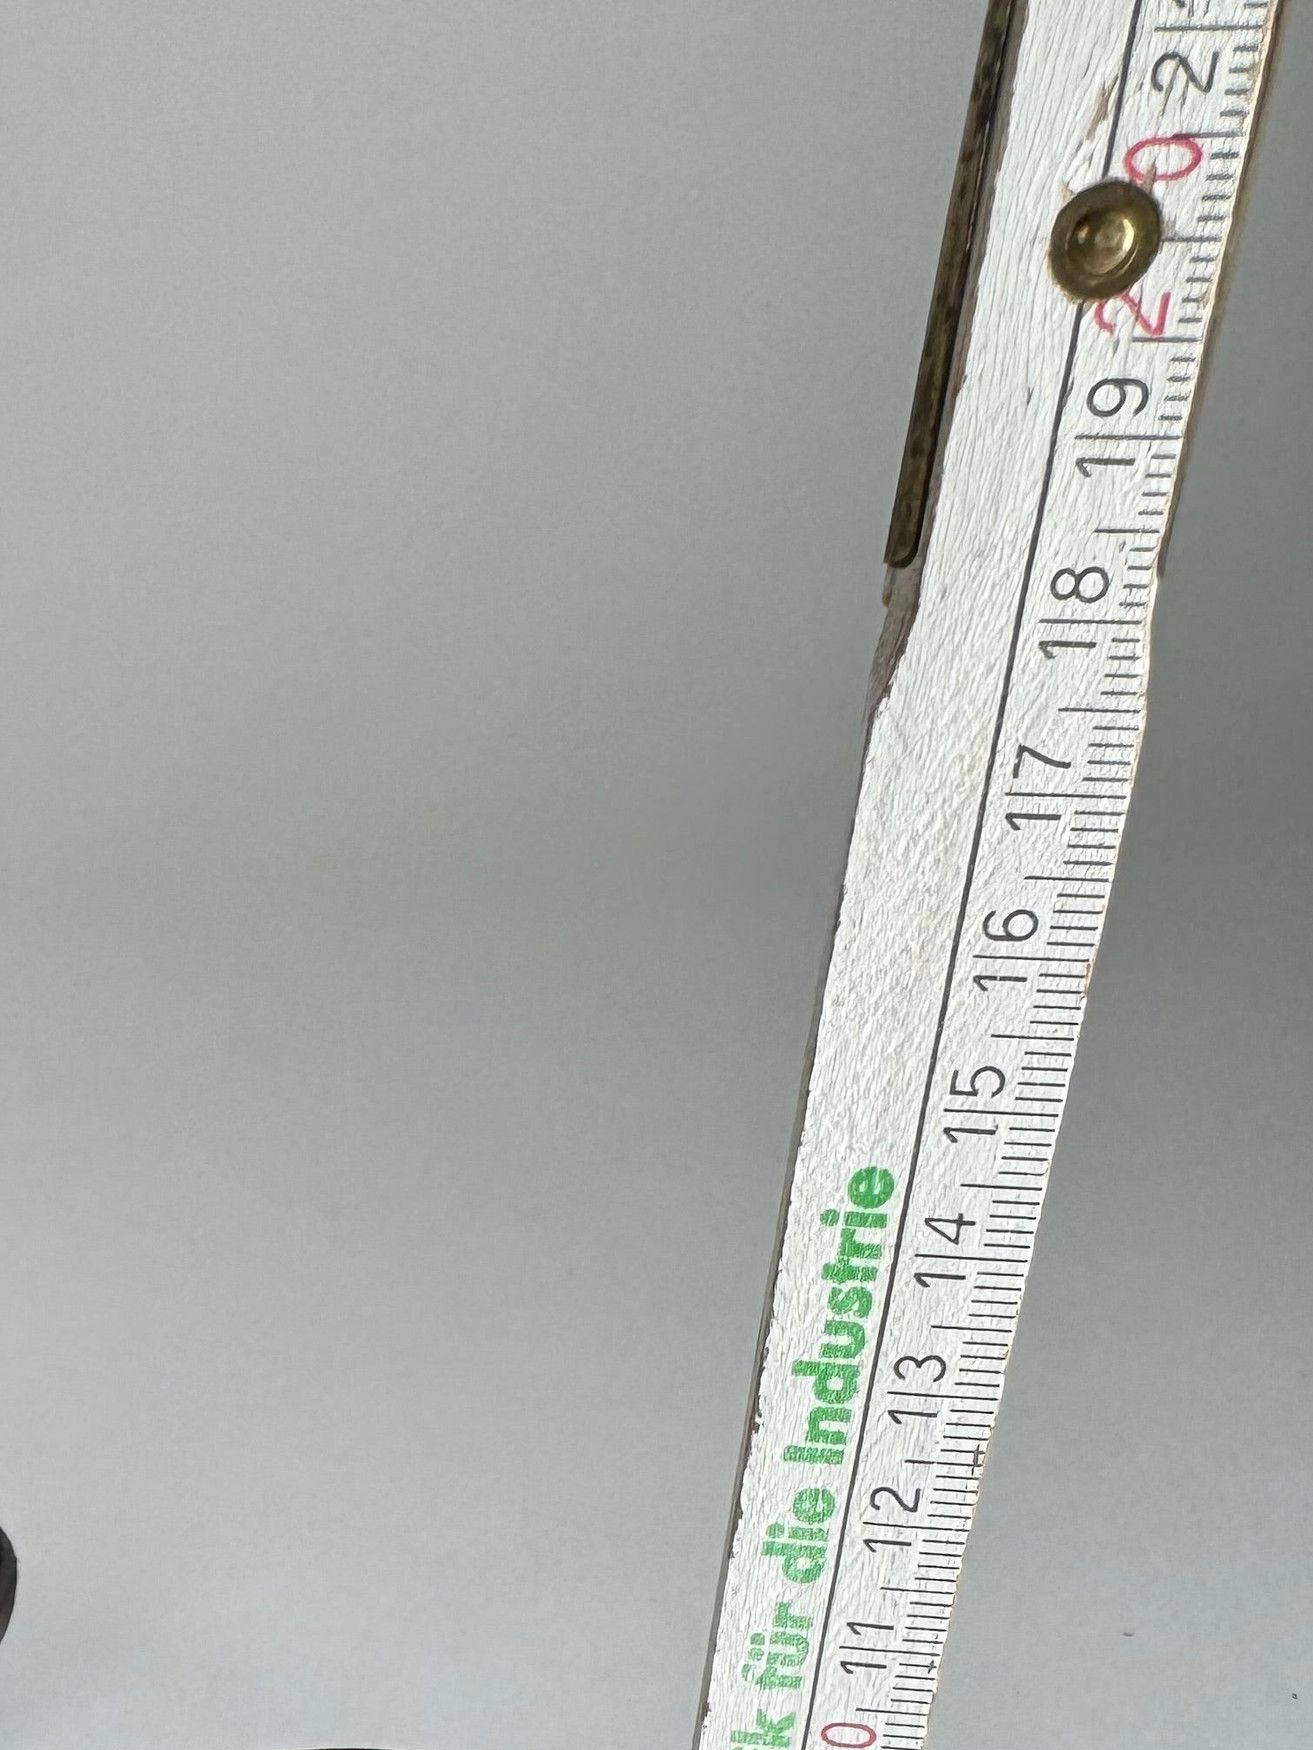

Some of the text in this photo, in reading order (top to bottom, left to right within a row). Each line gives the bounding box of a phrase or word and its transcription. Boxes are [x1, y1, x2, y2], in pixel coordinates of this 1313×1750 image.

[1150, 0, 1220, 94] 2
[1094, 136, 1203, 338] 20
[1075, 376, 1149, 478] 19
[1038, 565, 1112, 660] 18
[1004, 744, 1072, 831] 17
[972, 908, 1040, 992] 16
[943, 1064, 1007, 1144] 15
[913, 1212, 977, 1289] 14
[782, 1165, 896, 1466] Industrie
[887, 1354, 947, 1426] 13
[761, 1486, 836, 1585] die
[862, 1486, 923, 1554] 12
[740, 1600, 815, 1691] für
[840, 1620, 895, 1676] 11
